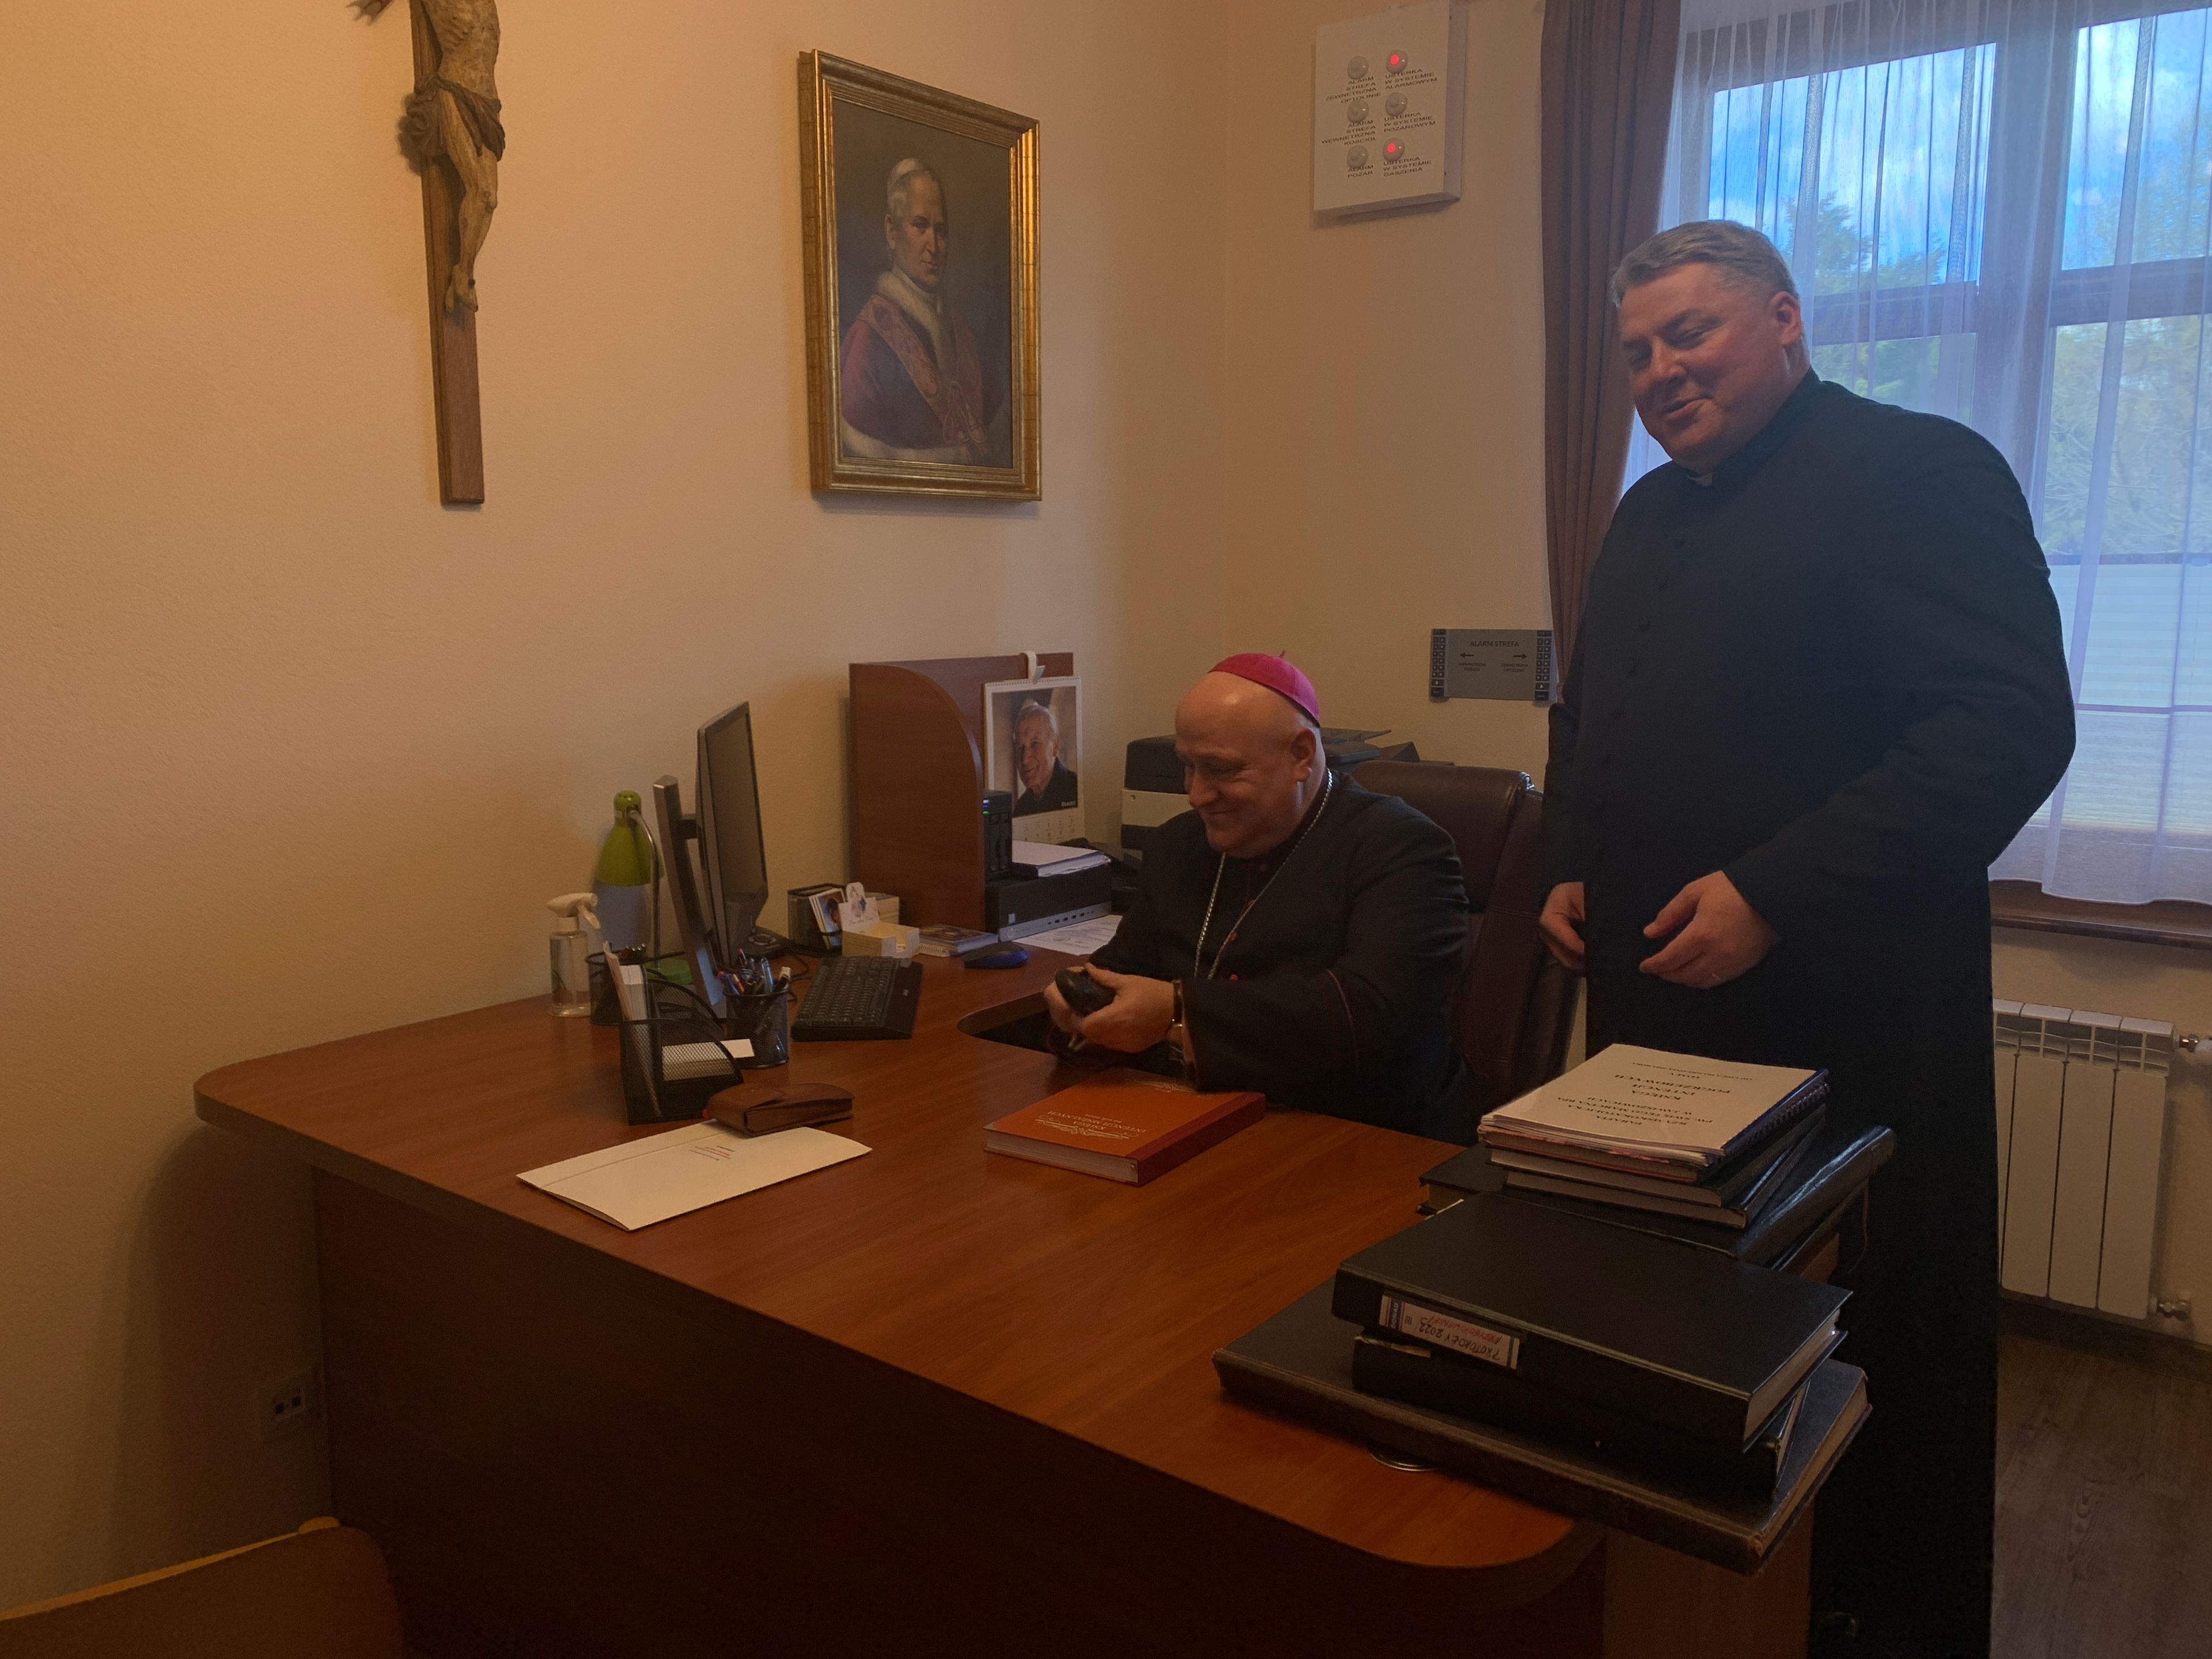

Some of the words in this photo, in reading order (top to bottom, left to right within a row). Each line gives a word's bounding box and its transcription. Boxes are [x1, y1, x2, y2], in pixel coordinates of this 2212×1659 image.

[1385, 69, 1422, 78] USTERKA
[1395, 73, 1434, 83] SYSTEMIE
[1348, 76, 1374, 84] ALARM
[1385, 77, 1437, 90] ALARMOWYM
[1346, 82, 1376, 91] STREFA
[1341, 93, 1381, 103] OPTOLINIE
[1384, 112, 1421, 121] USTERKA
[1393, 116, 1433, 126] SYSTEMIE
[1346, 126, 1376, 134] STREFA
[1384, 157, 1419, 165] USTERKA
[1393, 160, 1432, 170] SYSTEMIE
[1383, 167, 1423, 177] GASZENIA
[1615, 1074, 1730, 1093] POGRZEBOWYCH
[1633, 1084, 1696, 1095] INTENCJI
